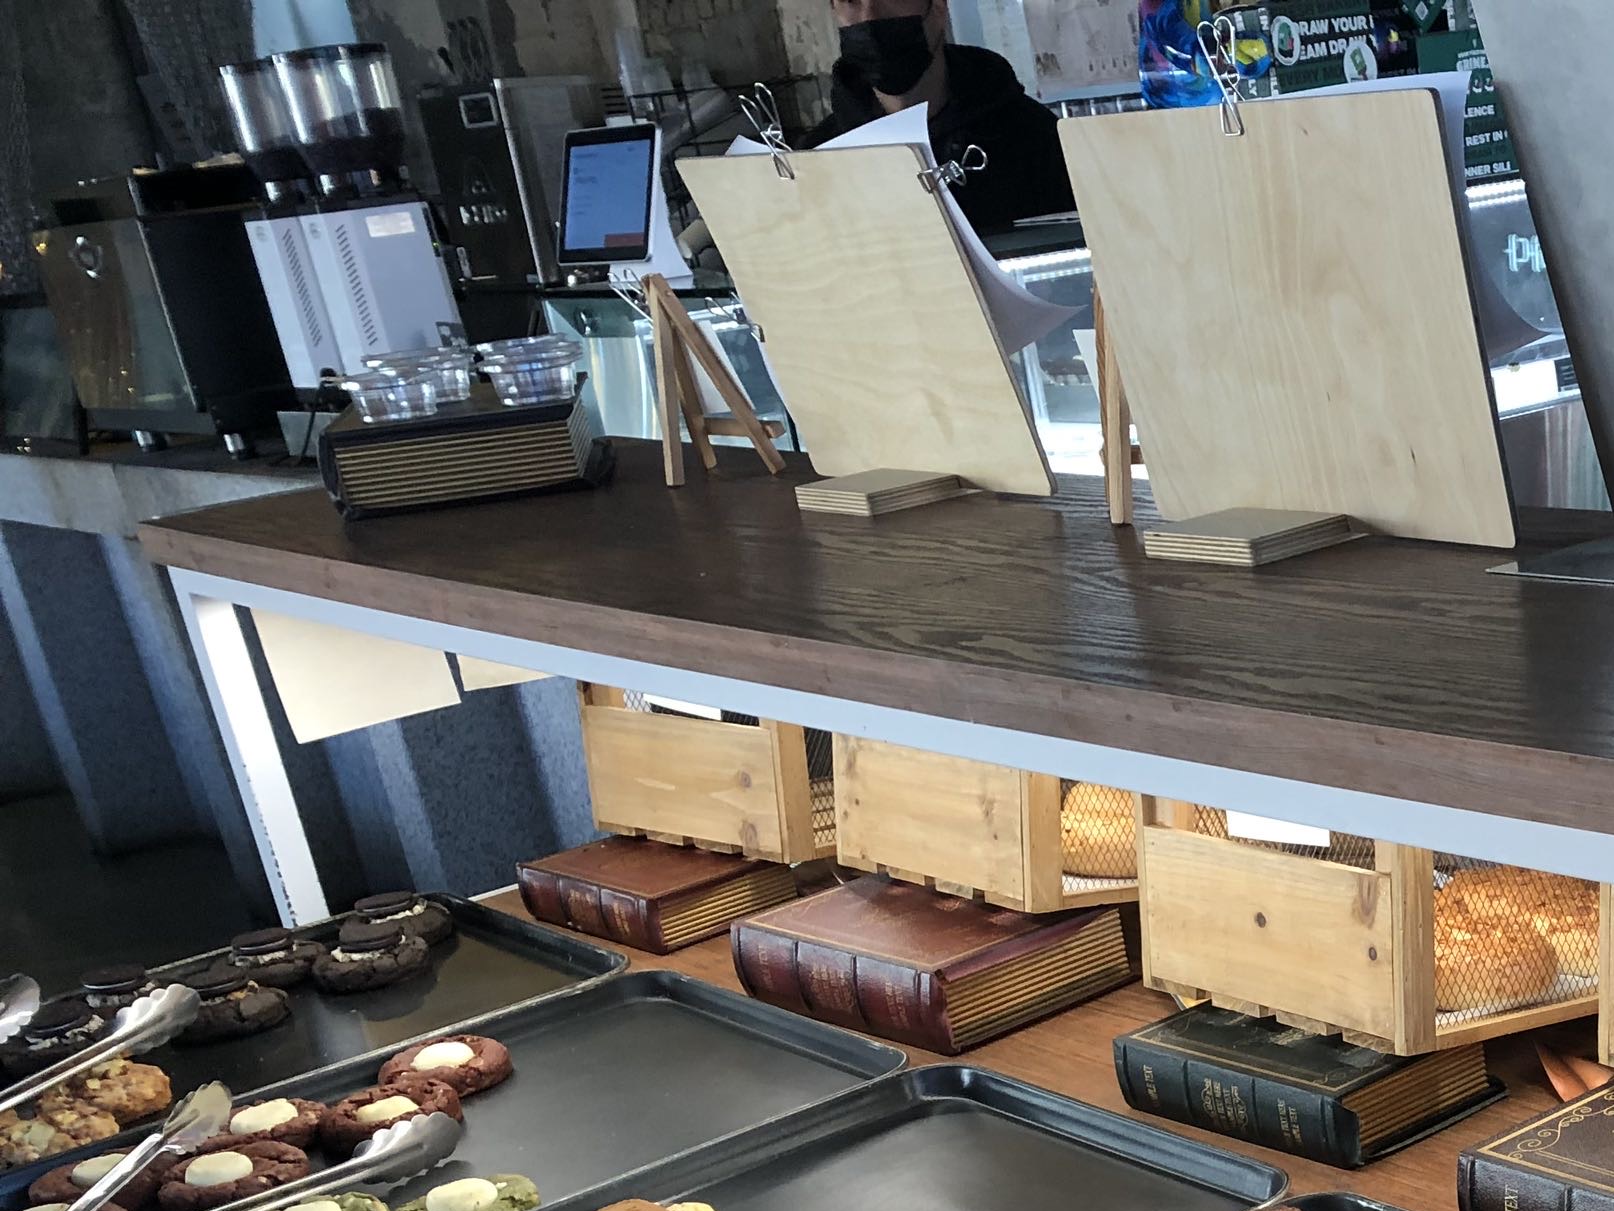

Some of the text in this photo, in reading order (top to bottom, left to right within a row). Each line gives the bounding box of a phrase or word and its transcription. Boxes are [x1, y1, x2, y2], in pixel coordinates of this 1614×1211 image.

[1298, 18, 1329, 36] RAW
[1330, 15, 1368, 33] YOUR
[1464, 105, 1495, 118] LENCE
[1465, 132, 1491, 147] REST
[1464, 163, 1492, 178] NNER
